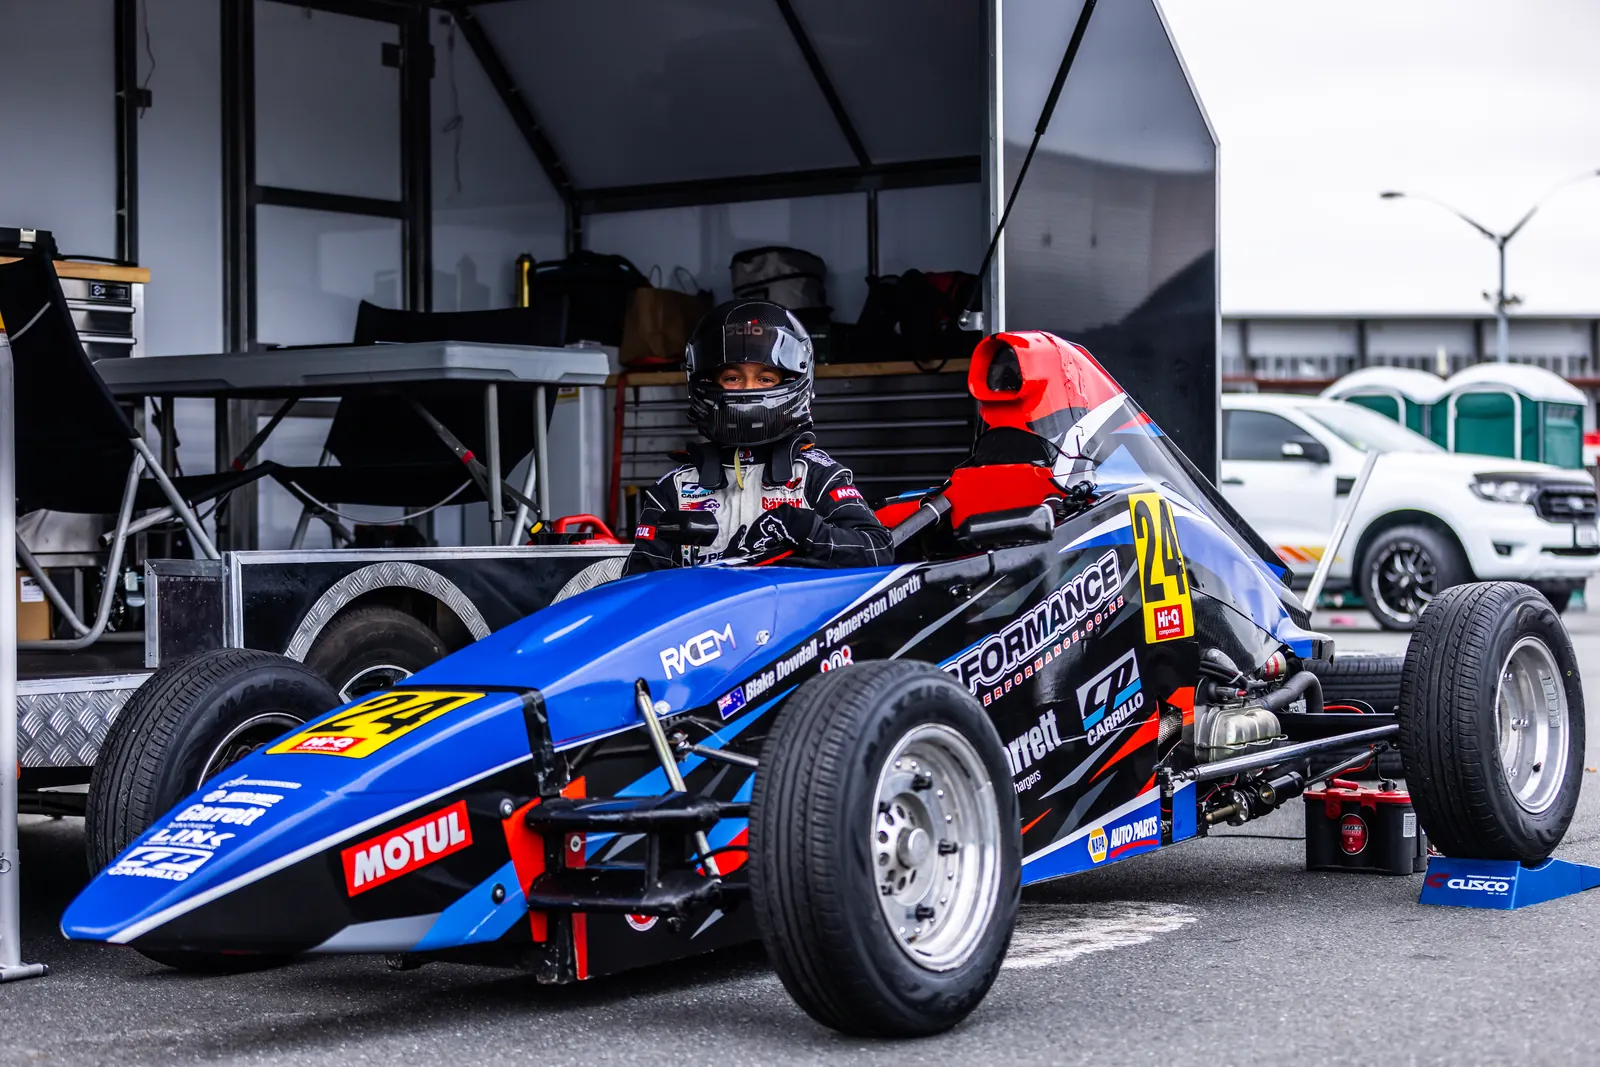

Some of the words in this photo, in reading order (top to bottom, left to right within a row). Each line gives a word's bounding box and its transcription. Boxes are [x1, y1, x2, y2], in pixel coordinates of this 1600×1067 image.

[681, 490, 716, 499] CARRILLO
[1134, 499, 1186, 603] 24
[745, 671, 776, 703] Blake
[776, 639, 818, 682] Dowdall
[825, 601, 888, 648] Palmerston
[888, 574, 922, 608] North
[1158, 627, 1181, 636] components
[982, 594, 1124, 707] ERFORMANCE.CO.NZ
[304, 694, 467, 735] 24
[1086, 691, 1145, 746] CARRILLO
[1013, 769, 1042, 795] hargers
[175, 804, 267, 827] Garrett
[1091, 835, 1106, 854] NAPA
[1110, 822, 1132, 849] AUTO
[1132, 816, 1158, 845] PARTS
[354, 811, 465, 888] MOTUL
[108, 866, 189, 882] CARRILLO
[1447, 878, 1510, 893] CUSCO
